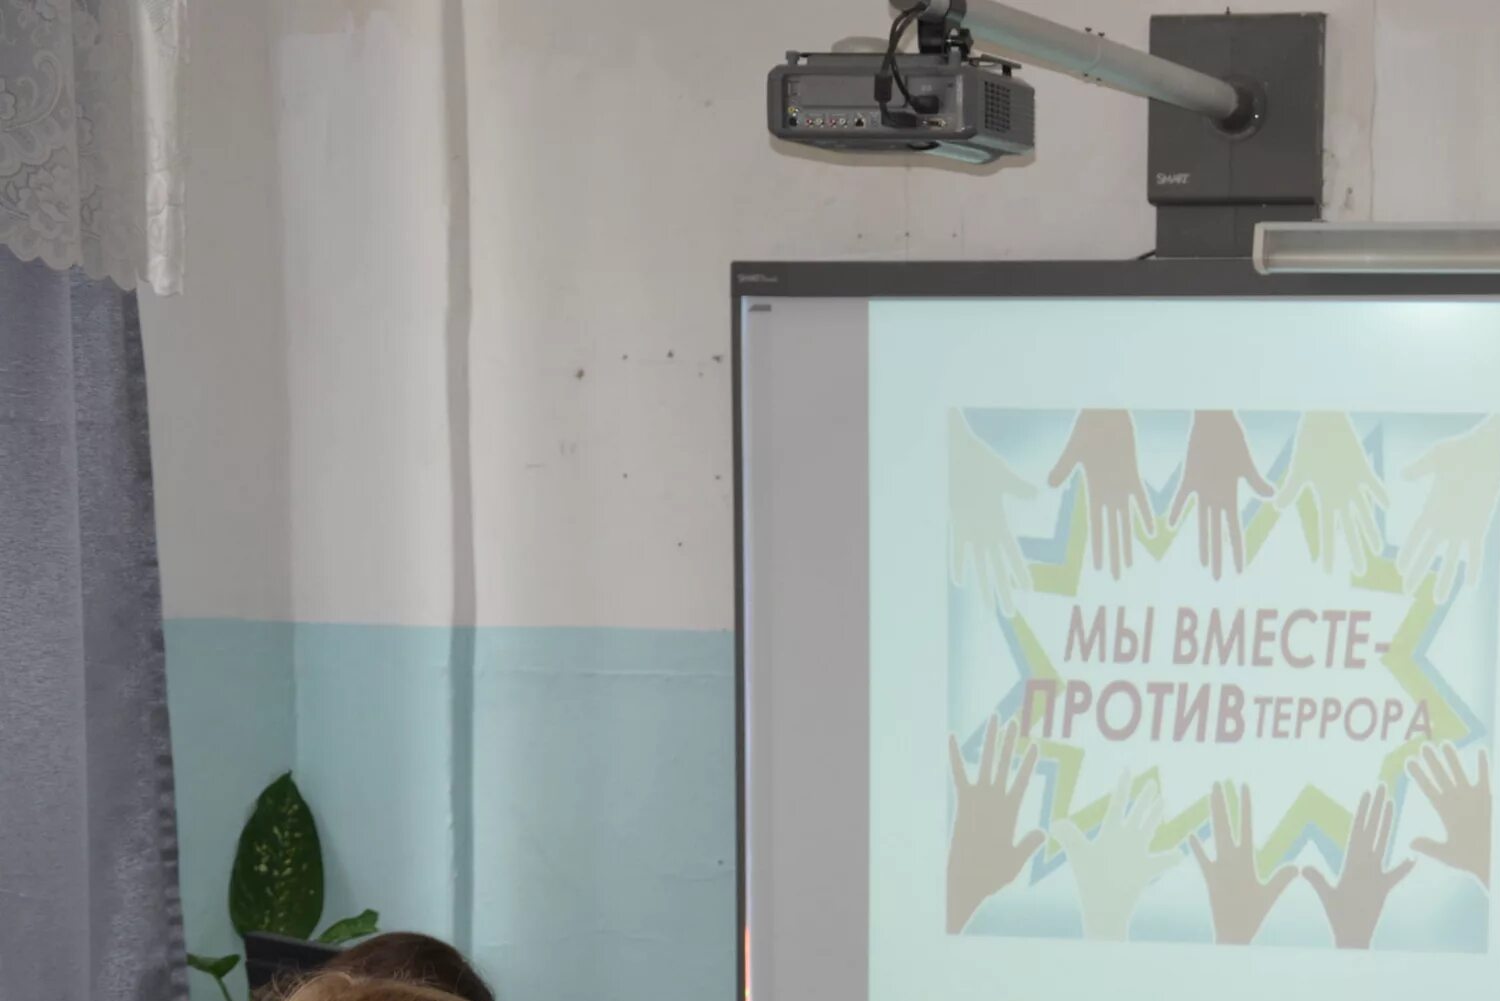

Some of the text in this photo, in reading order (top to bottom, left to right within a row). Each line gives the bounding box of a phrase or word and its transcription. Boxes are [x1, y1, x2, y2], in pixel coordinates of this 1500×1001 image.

[1064, 605, 1391, 669] МЫ ВМЕСТЕ-
[1019, 677, 1434, 744] ПРОТИВ ТЕРРОРА
